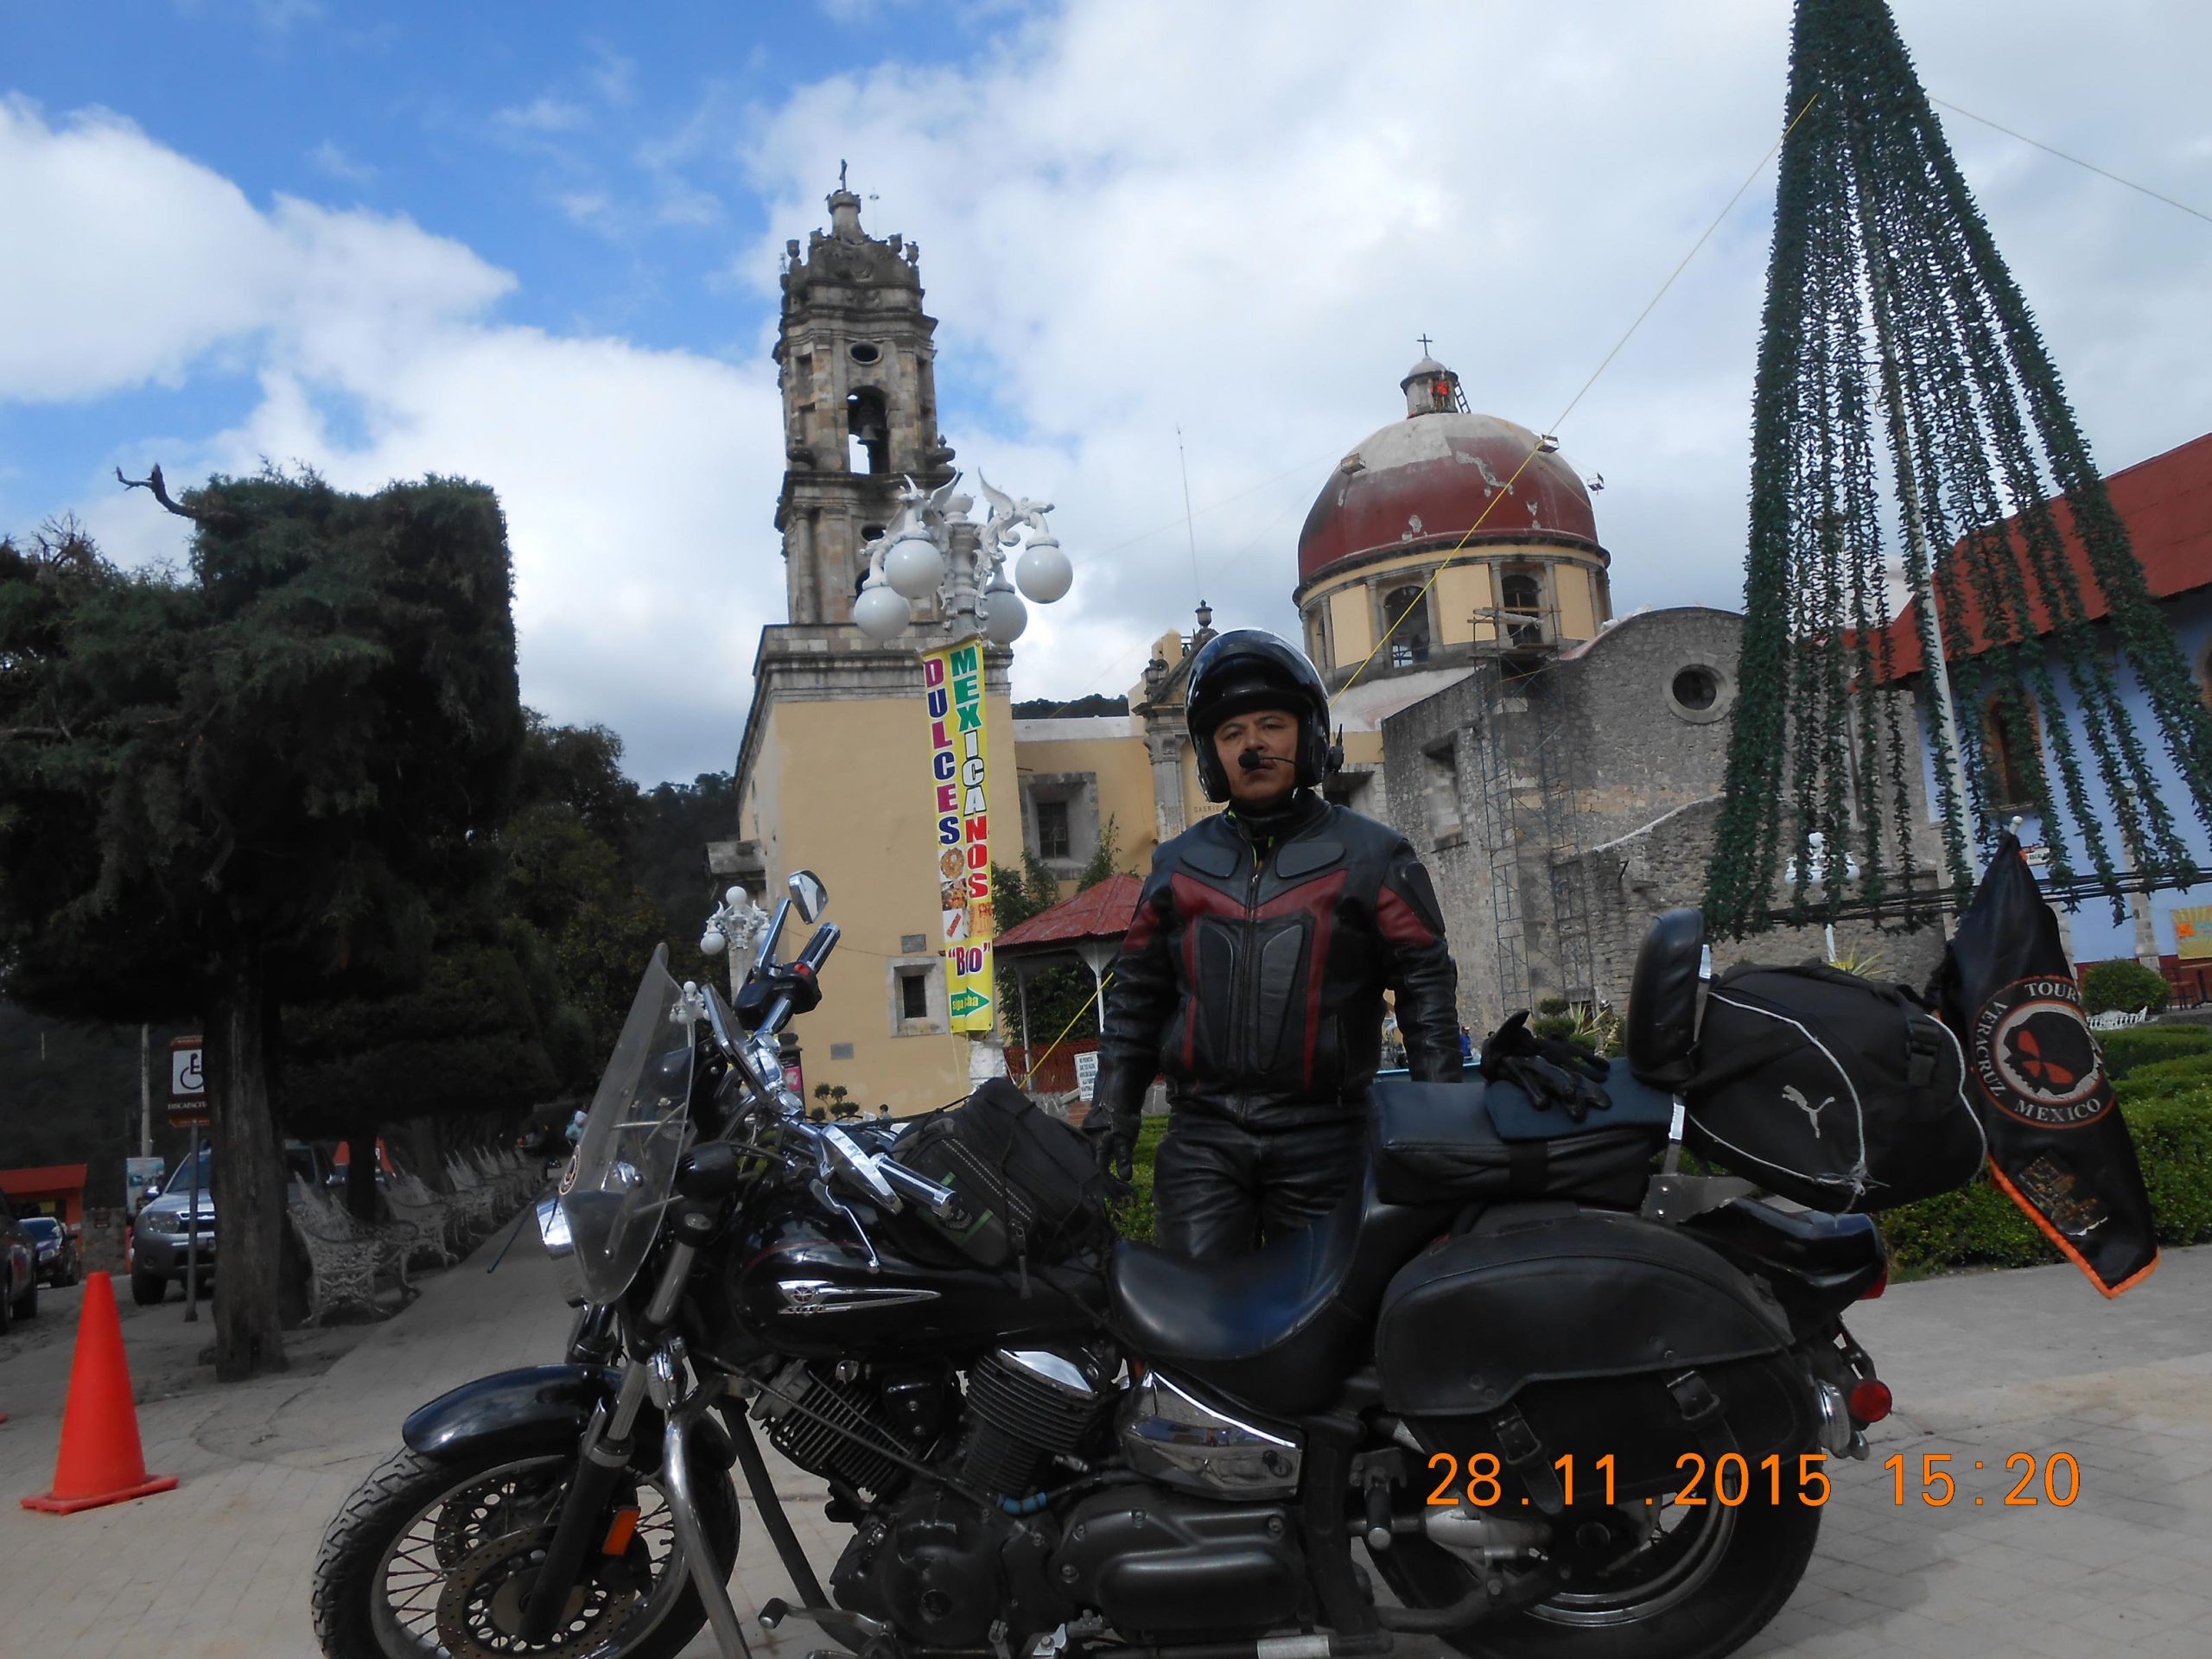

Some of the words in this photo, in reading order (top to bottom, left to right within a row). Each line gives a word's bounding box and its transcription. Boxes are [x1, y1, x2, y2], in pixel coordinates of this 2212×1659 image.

[923, 658, 961, 845] DULCES
[950, 645, 988, 899] MEXICANOS
[1976, 1001, 2008, 1096] VERACRUZ
[2014, 1098, 2101, 1122] MEXICO
